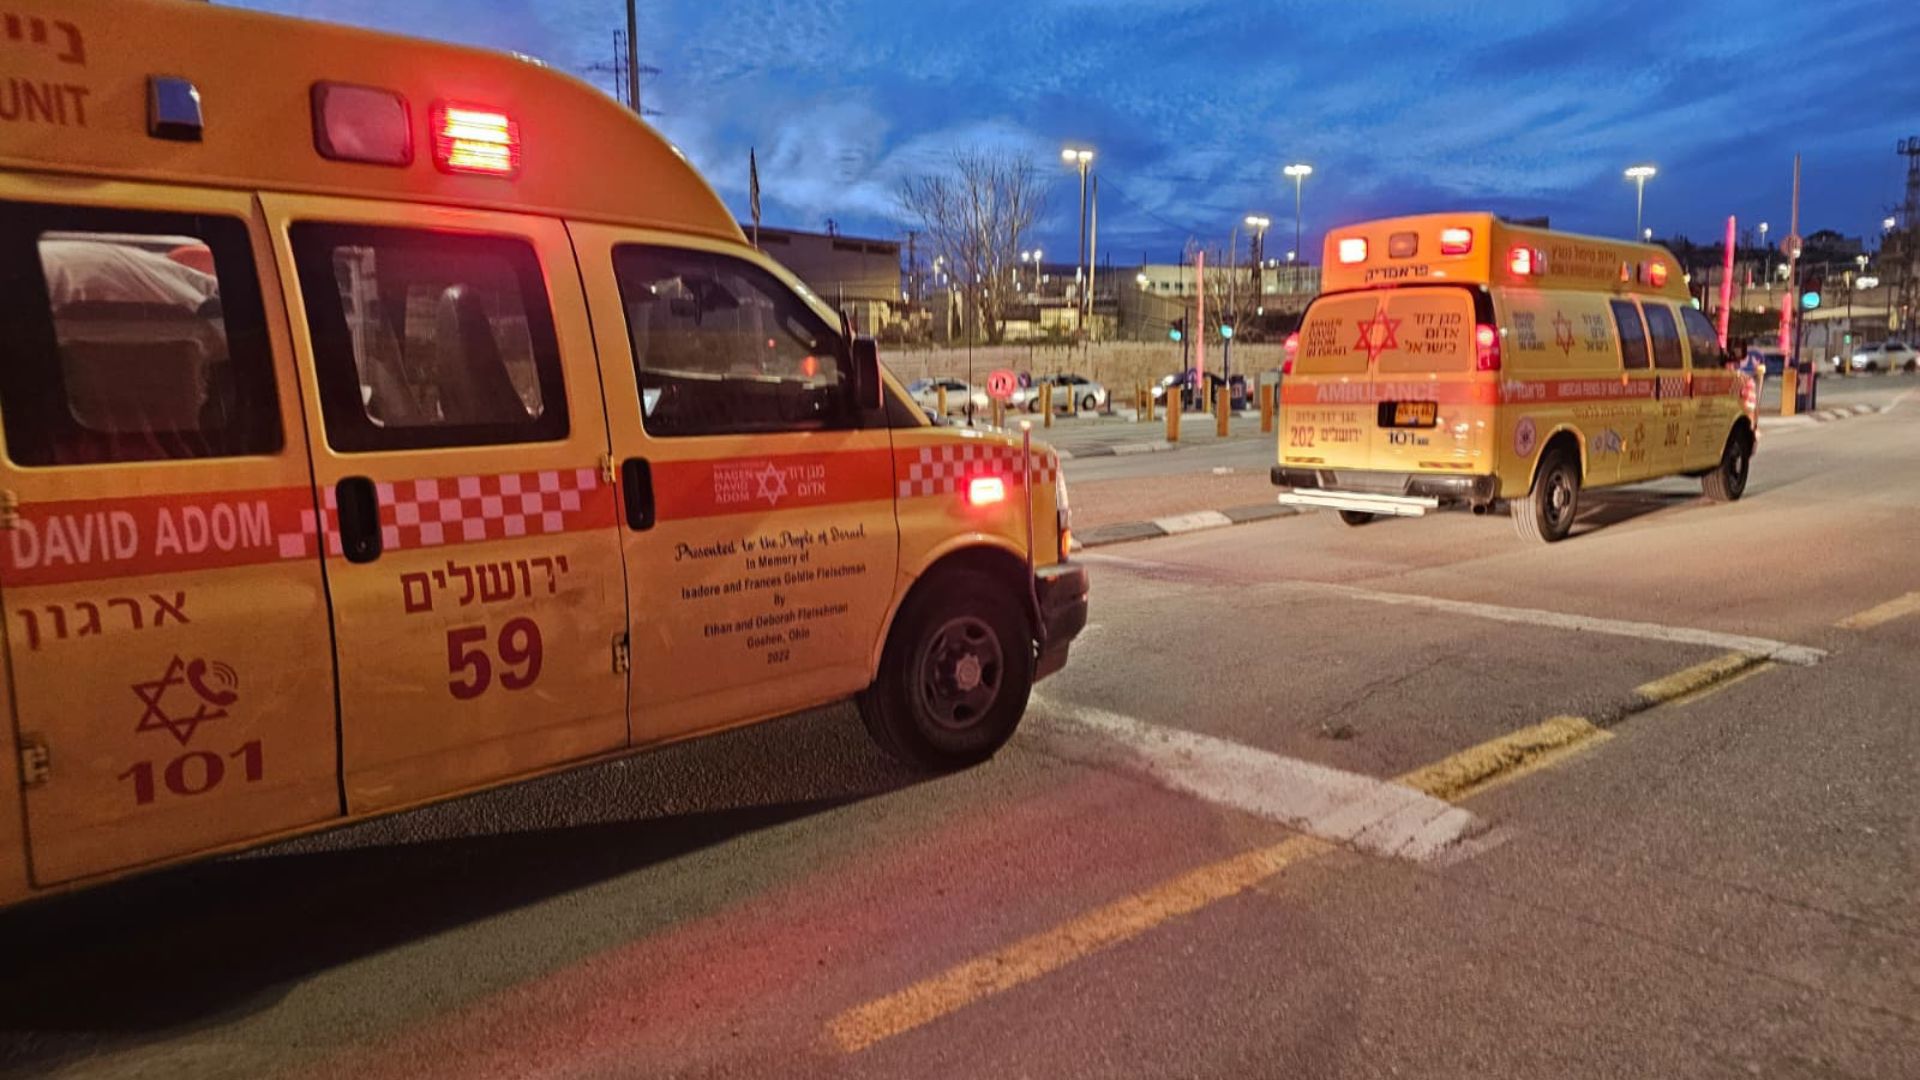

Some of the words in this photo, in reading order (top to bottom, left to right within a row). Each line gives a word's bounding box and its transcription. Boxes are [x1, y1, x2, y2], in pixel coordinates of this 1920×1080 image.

[0, 77, 90, 127] UNIT
[1316, 383, 1441, 402] AMBULANCE
[1290, 427, 1316, 448] 202
[1388, 431, 1416, 445] 101
[713, 470, 754, 482] MAGEN
[714, 480, 749, 493] DAVID
[715, 491, 749, 503] ADOM
[798, 481, 826, 497] אדום
[9, 510, 139, 569] DAVID
[155, 500, 272, 556] ADOM
[674, 540, 737, 562] Presented
[741, 539, 755, 552] to
[760, 535, 778, 550] the
[779, 530, 814, 550] People
[818, 531, 828, 546] of
[746, 558, 756, 571] In
[758, 553, 798, 569] Memory
[800, 551, 809, 564] of
[401, 555, 570, 614] ירושלים
[681, 585, 721, 600] Isadore
[723, 579, 742, 593] and
[745, 577, 782, 592] Frances
[774, 593, 785, 608] By
[18, 591, 191, 650] ארגון
[735, 619, 753, 633] and
[756, 610, 796, 629] Deborah
[789, 627, 811, 642] Ohio
[446, 617, 544, 700] 59
[118, 740, 264, 805] 101
